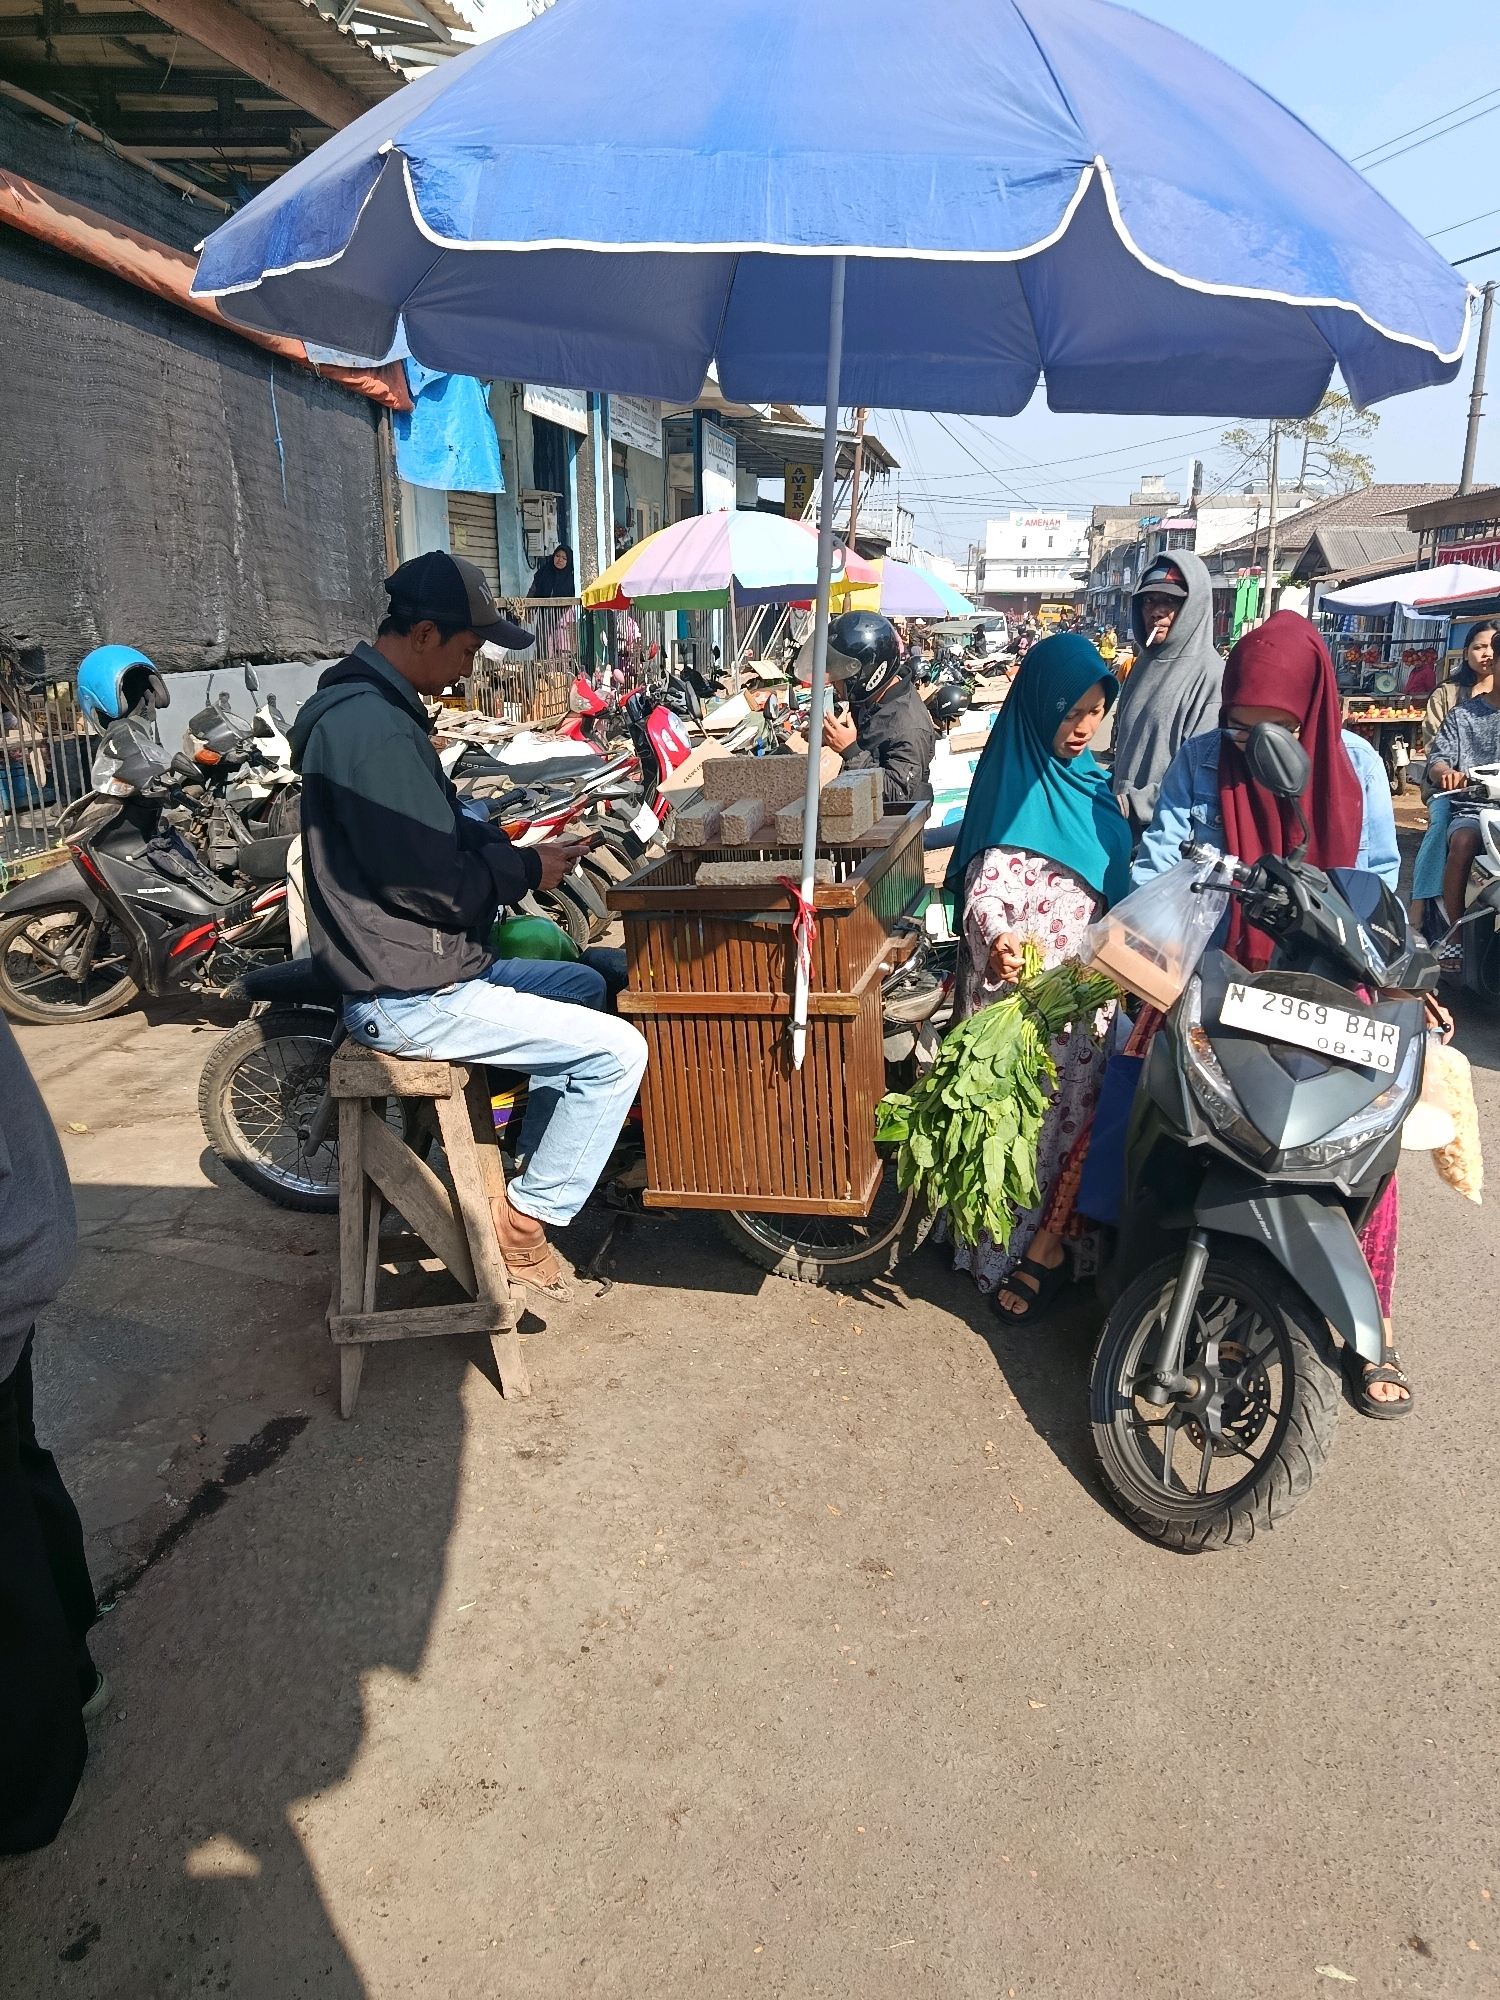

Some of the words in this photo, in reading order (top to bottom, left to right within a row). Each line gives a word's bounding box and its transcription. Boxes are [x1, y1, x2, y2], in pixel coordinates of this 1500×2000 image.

[790, 467, 808, 509] AMIEN
[1370, 923, 1401, 947] HONDA
[1230, 984, 1246, 1003] N
[1262, 993, 1328, 1026] 2969
[1345, 1014, 1396, 1045] BAR
